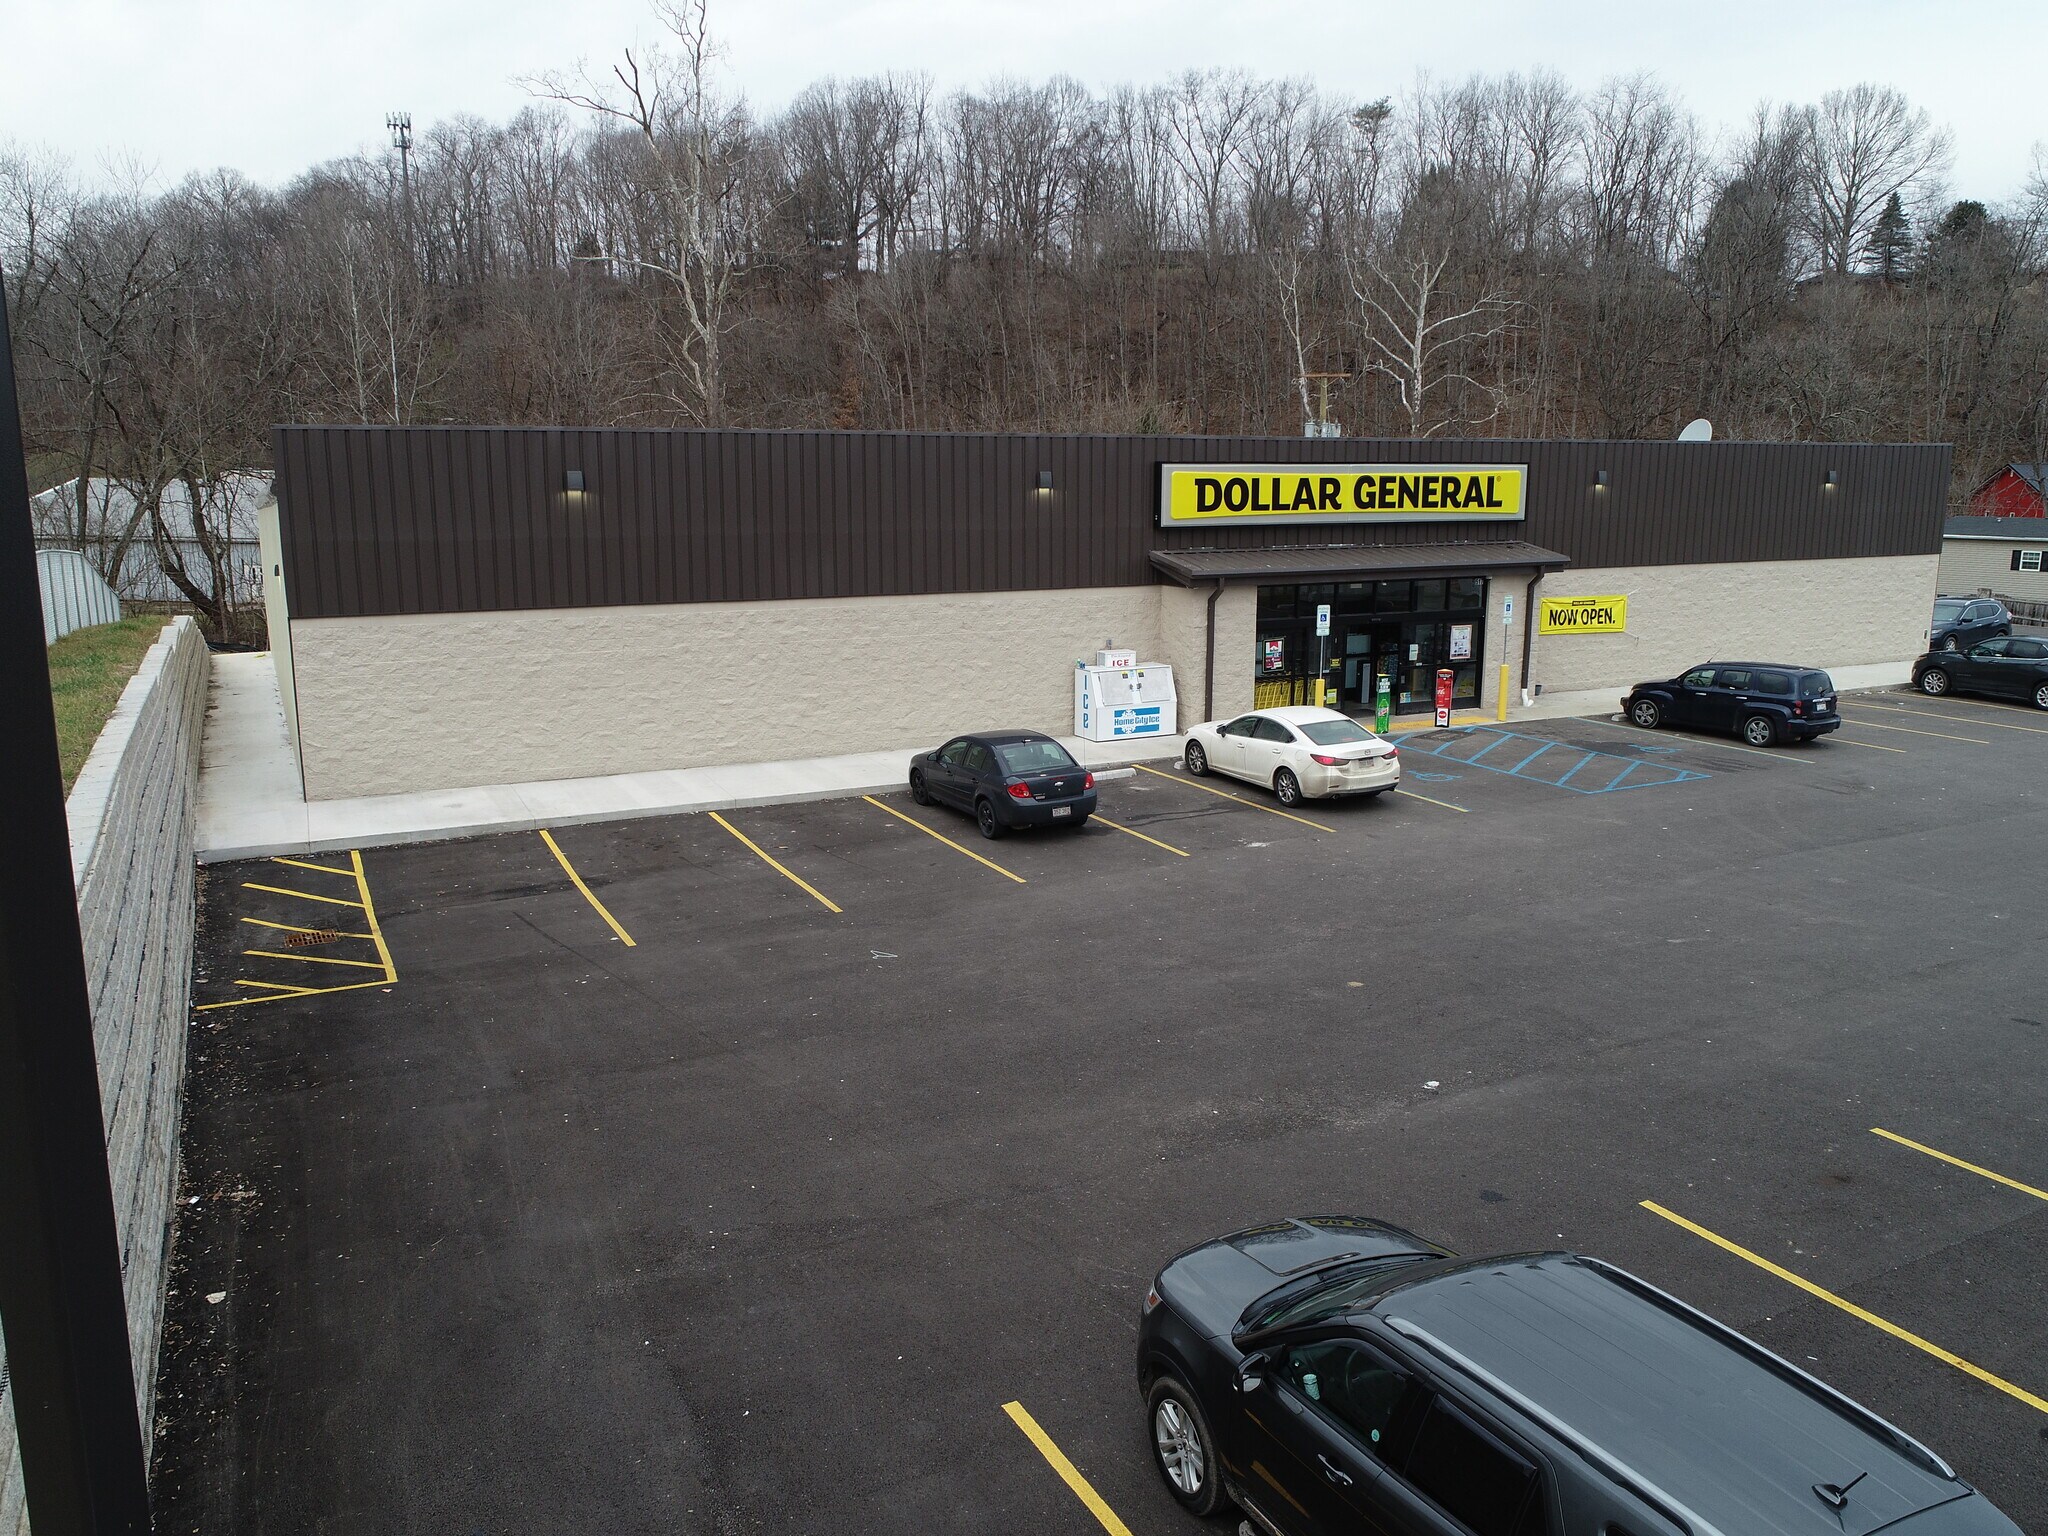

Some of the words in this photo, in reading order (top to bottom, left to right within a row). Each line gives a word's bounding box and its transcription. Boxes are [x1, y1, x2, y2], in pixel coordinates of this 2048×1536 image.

[1195, 477, 1342, 512] DOLLAR
[1353, 475, 1503, 509] GENERAL
[1548, 609, 1579, 626] NOW
[1580, 607, 1616, 625] OPEN.
[1112, 659, 1130, 667] ICE
[1114, 717, 1135, 726] Home
[1135, 715, 1148, 726] City
[1148, 715, 1160, 723] Ice
